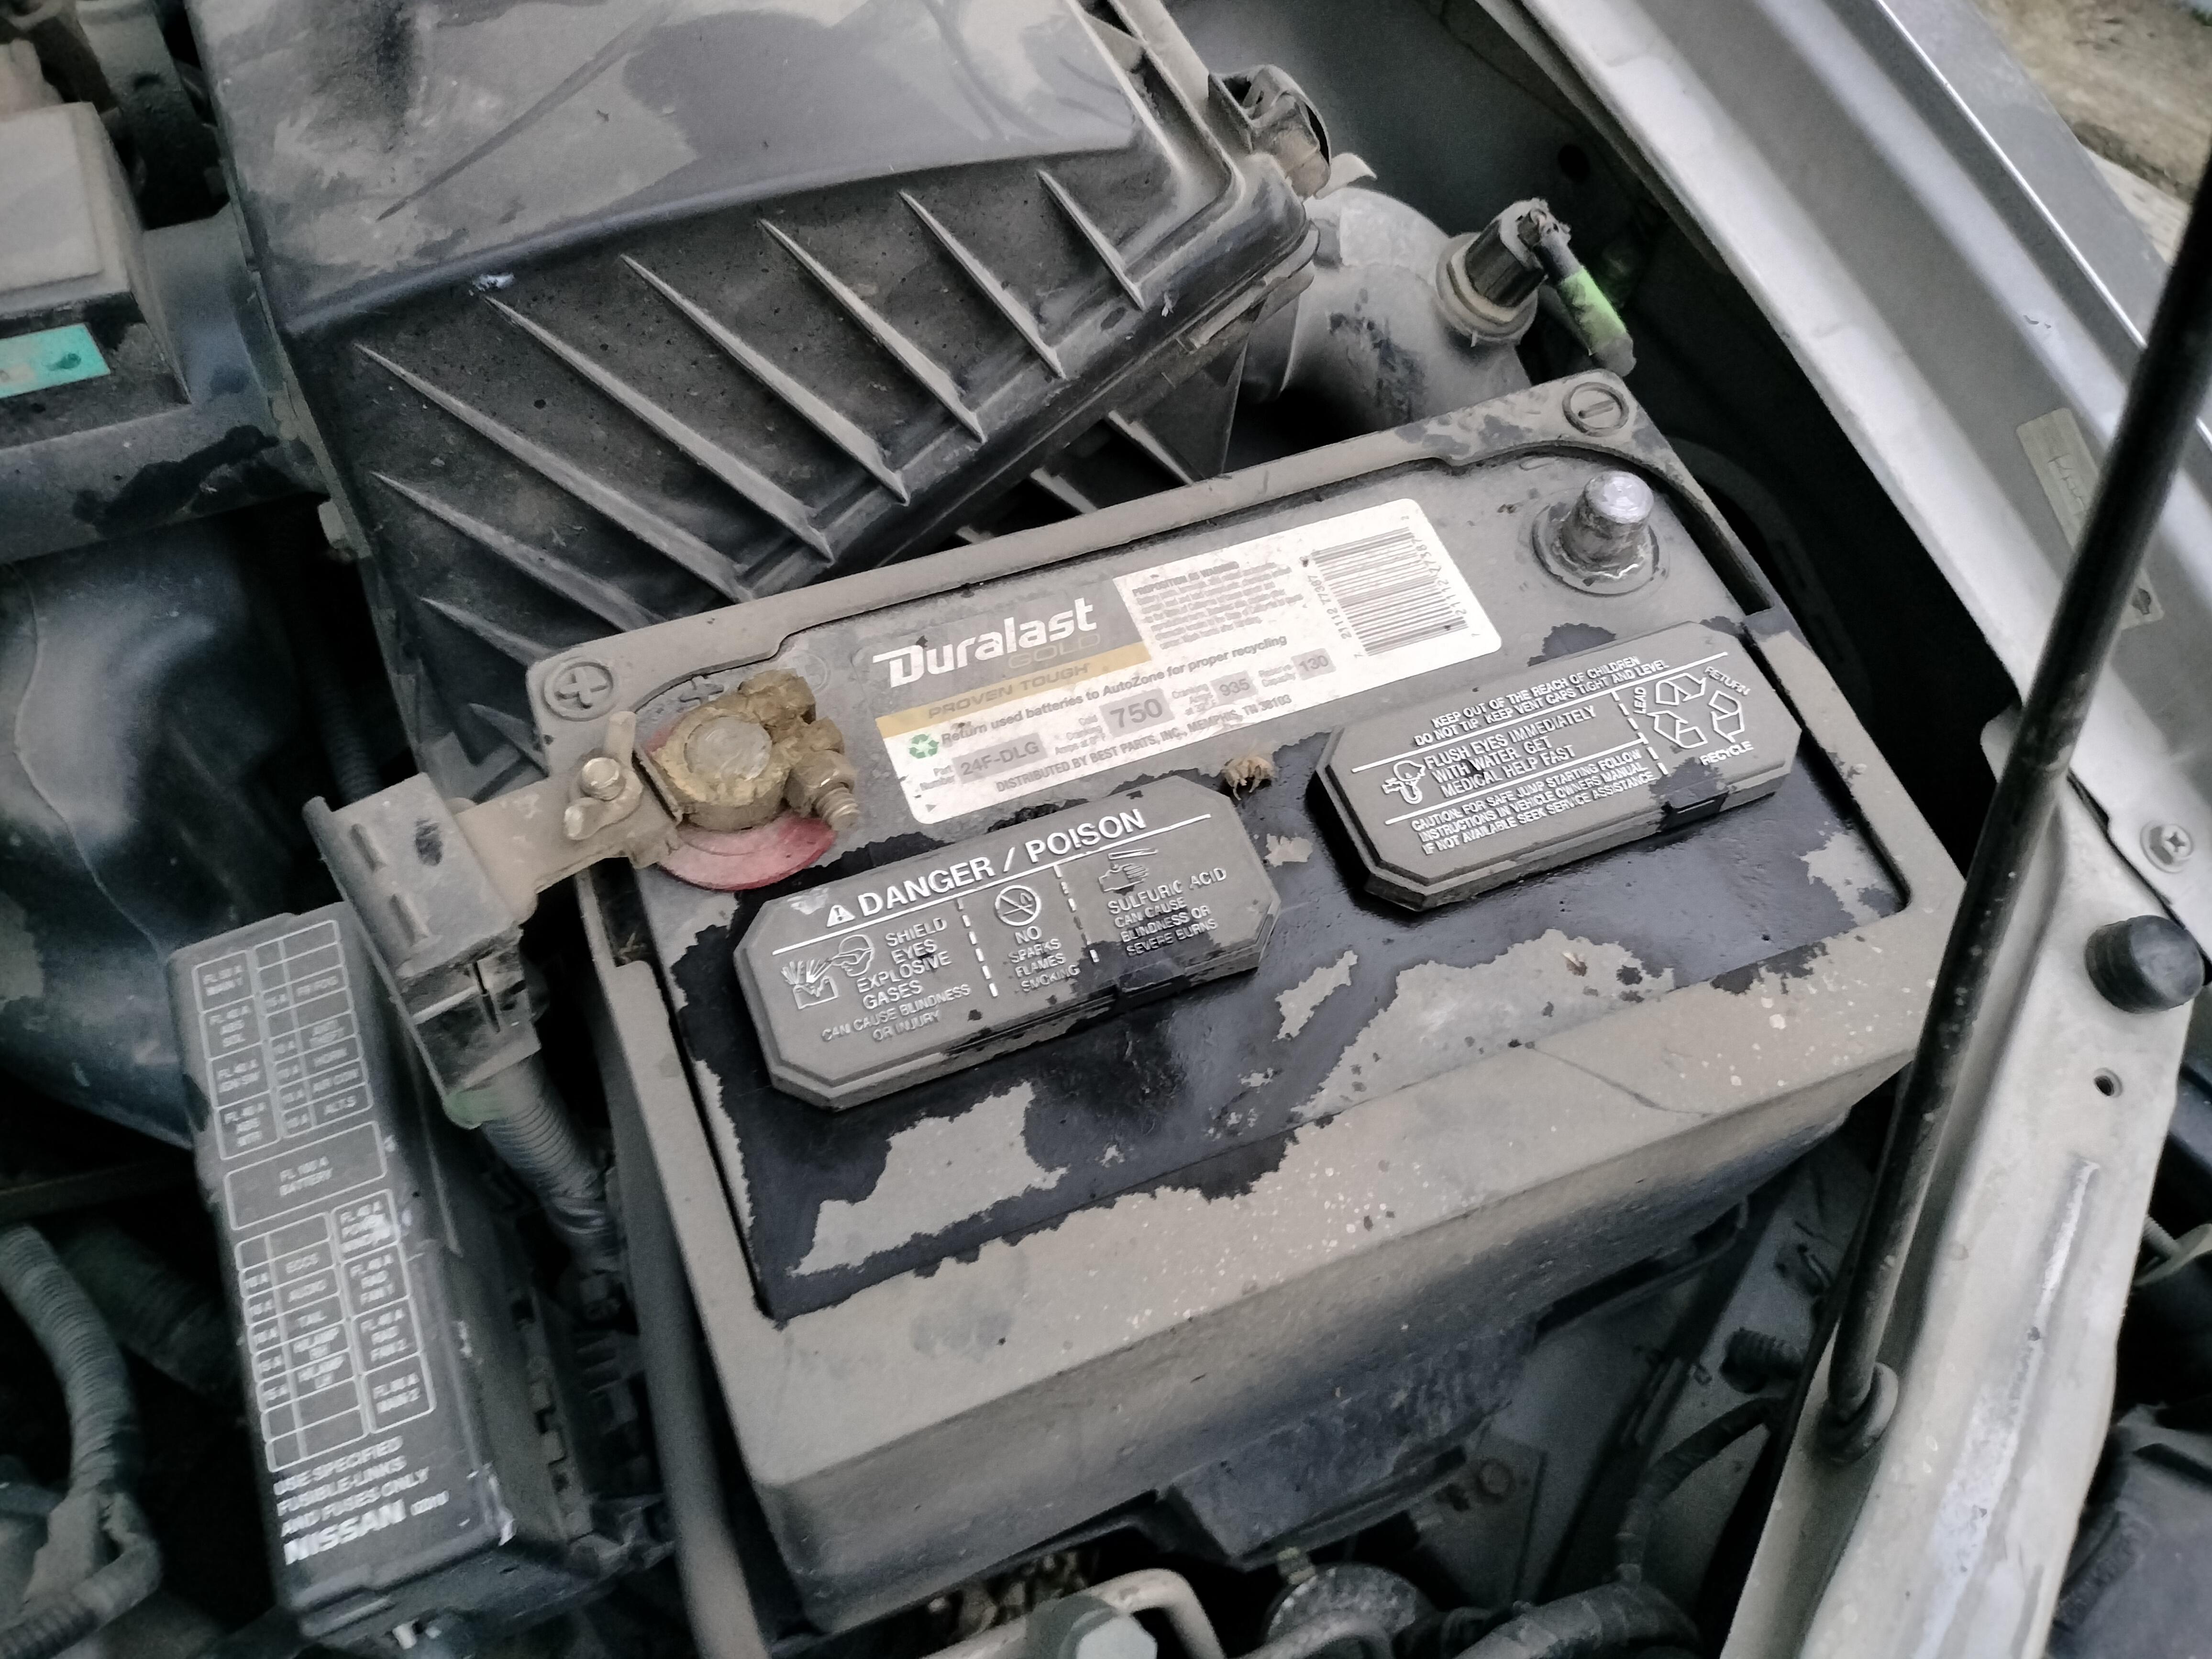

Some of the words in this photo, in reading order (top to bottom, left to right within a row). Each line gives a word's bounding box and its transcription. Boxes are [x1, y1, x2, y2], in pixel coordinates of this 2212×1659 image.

[873, 597, 1096, 687] Duralast
[1007, 633, 1100, 669] GOLD
[1298, 654, 1329, 673] 130
[1703, 666, 1751, 696] RETURN
[929, 684, 1012, 719] PROVEN
[1020, 663, 1090, 690] TOUGH
[941, 721, 987, 744] Return
[991, 712, 1023, 729] used
[1026, 696, 1084, 719] batteries
[1086, 690, 1100, 700] to
[1103, 671, 1165, 696] AutoZone
[1167, 664, 1186, 676] for
[1188, 652, 1228, 672] proper
[1232, 636, 1288, 657] recycling
[1219, 678, 1250, 697] 935
[1414, 732, 1433, 746] DO
[1434, 724, 1460, 741] NOT
[1485, 708, 1514, 724] KEEP
[1514, 698, 1544, 714] VENT
[1545, 688, 1577, 706] CAPS
[1576, 676, 1609, 695] TIGHT
[1611, 668, 1636, 684] AND
[1636, 659, 1670, 676] LEVEL
[1432, 711, 1461, 728] KEEP
[1463, 703, 1487, 718] OUT
[1489, 697, 1505, 709] OF
[1506, 690, 1530, 705] THE
[1530, 678, 1569, 696] REACH
[1569, 672, 1584, 685] OF
[1587, 656, 1641, 679] CHILDREN
[1634, 686, 1647, 715] LEAD
[1110, 698, 1163, 729] 750
[996, 761, 1071, 792] DISTRIBUTED
[1072, 755, 1088, 768] BY
[1090, 746, 1119, 763] BEST
[1121, 734, 1160, 753] PARTS,
[1242, 704, 1258, 715] TN
[1424, 746, 1471, 770] FLUSH
[1470, 733, 1508, 754] EYES
[1508, 705, 1597, 744] IMMEDIATELY
[1699, 741, 1754, 765] RECYCLE
[933, 765, 952, 777] Part
[961, 741, 1040, 775] 24F-DLG
[1431, 762, 1471, 784] WITH
[1470, 747, 1521, 771] WATER
[1524, 736, 1553, 754] GET
[1439, 769, 1503, 798] MEDICAL
[1501, 757, 1538, 778] HELP
[1541, 744, 1576, 766] FAST
[919, 774, 955, 791] Number
[1461, 800, 1486, 815] FOR
[1486, 790, 1517, 807] SAFE
[1516, 781, 1546, 797] JUMP
[1546, 763, 1600, 787] STARTING
[1598, 749, 1642, 771] FOLLOW
[1418, 810, 1498, 842] INSTRUCTIONS
[1496, 805, 1512, 817] IN
[1510, 791, 1556, 812] VEHICLE
[1555, 775, 1601, 800] OWNERS
[1601, 762, 1648, 783] MANUAL
[1422, 842, 1437, 855] IF
[1436, 834, 1460, 851] NOT
[1462, 817, 1518, 843] AVAILABLE
[1517, 807, 1548, 824] SEEK
[1546, 790, 1592, 816] SERVICE
[1593, 771, 1658, 800] ASSISTANCE
[858, 856, 996, 917] DANGER
[1004, 847, 1015, 872] /
[1025, 808, 1147, 863] POISON
[1108, 880, 1183, 915] SULFURIC
[1189, 868, 1227, 890] ACID
[1115, 909, 1143, 929] CAN
[1144, 896, 1188, 918] CAUSE
[1120, 912, 1191, 943] BLINDNESS
[1193, 905, 1211, 919] OR
[885, 917, 948, 947] SHIELD
[1007, 938, 1062, 964] SPARKS
[1014, 926, 1042, 945] NO
[1126, 932, 1174, 956] SEVERE
[1175, 918, 1218, 941] BURNS
[891, 939, 938, 964] EYES
[1015, 952, 1067, 978] FLAMES
[857, 951, 952, 993] EXPLOSIVE
[1020, 964, 1081, 993] SMOKING
[821, 1022, 851, 1041] CAN
[853, 1007, 897, 1031] CAUSE
[899, 984, 973, 1017] BLINDNESS
[863, 980, 924, 1009] GASES
[873, 1027, 893, 1041] OR
[895, 1010, 940, 1036] INJURY
[273, 1470, 312, 1495] USE
[312, 1435, 403, 1482] SPECIFIED
[281, 1510, 321, 1537] AND
[321, 1486, 382, 1521] FUSES
[381, 1467, 430, 1497] ONLY
[284, 1499, 407, 1565] NISSAN
